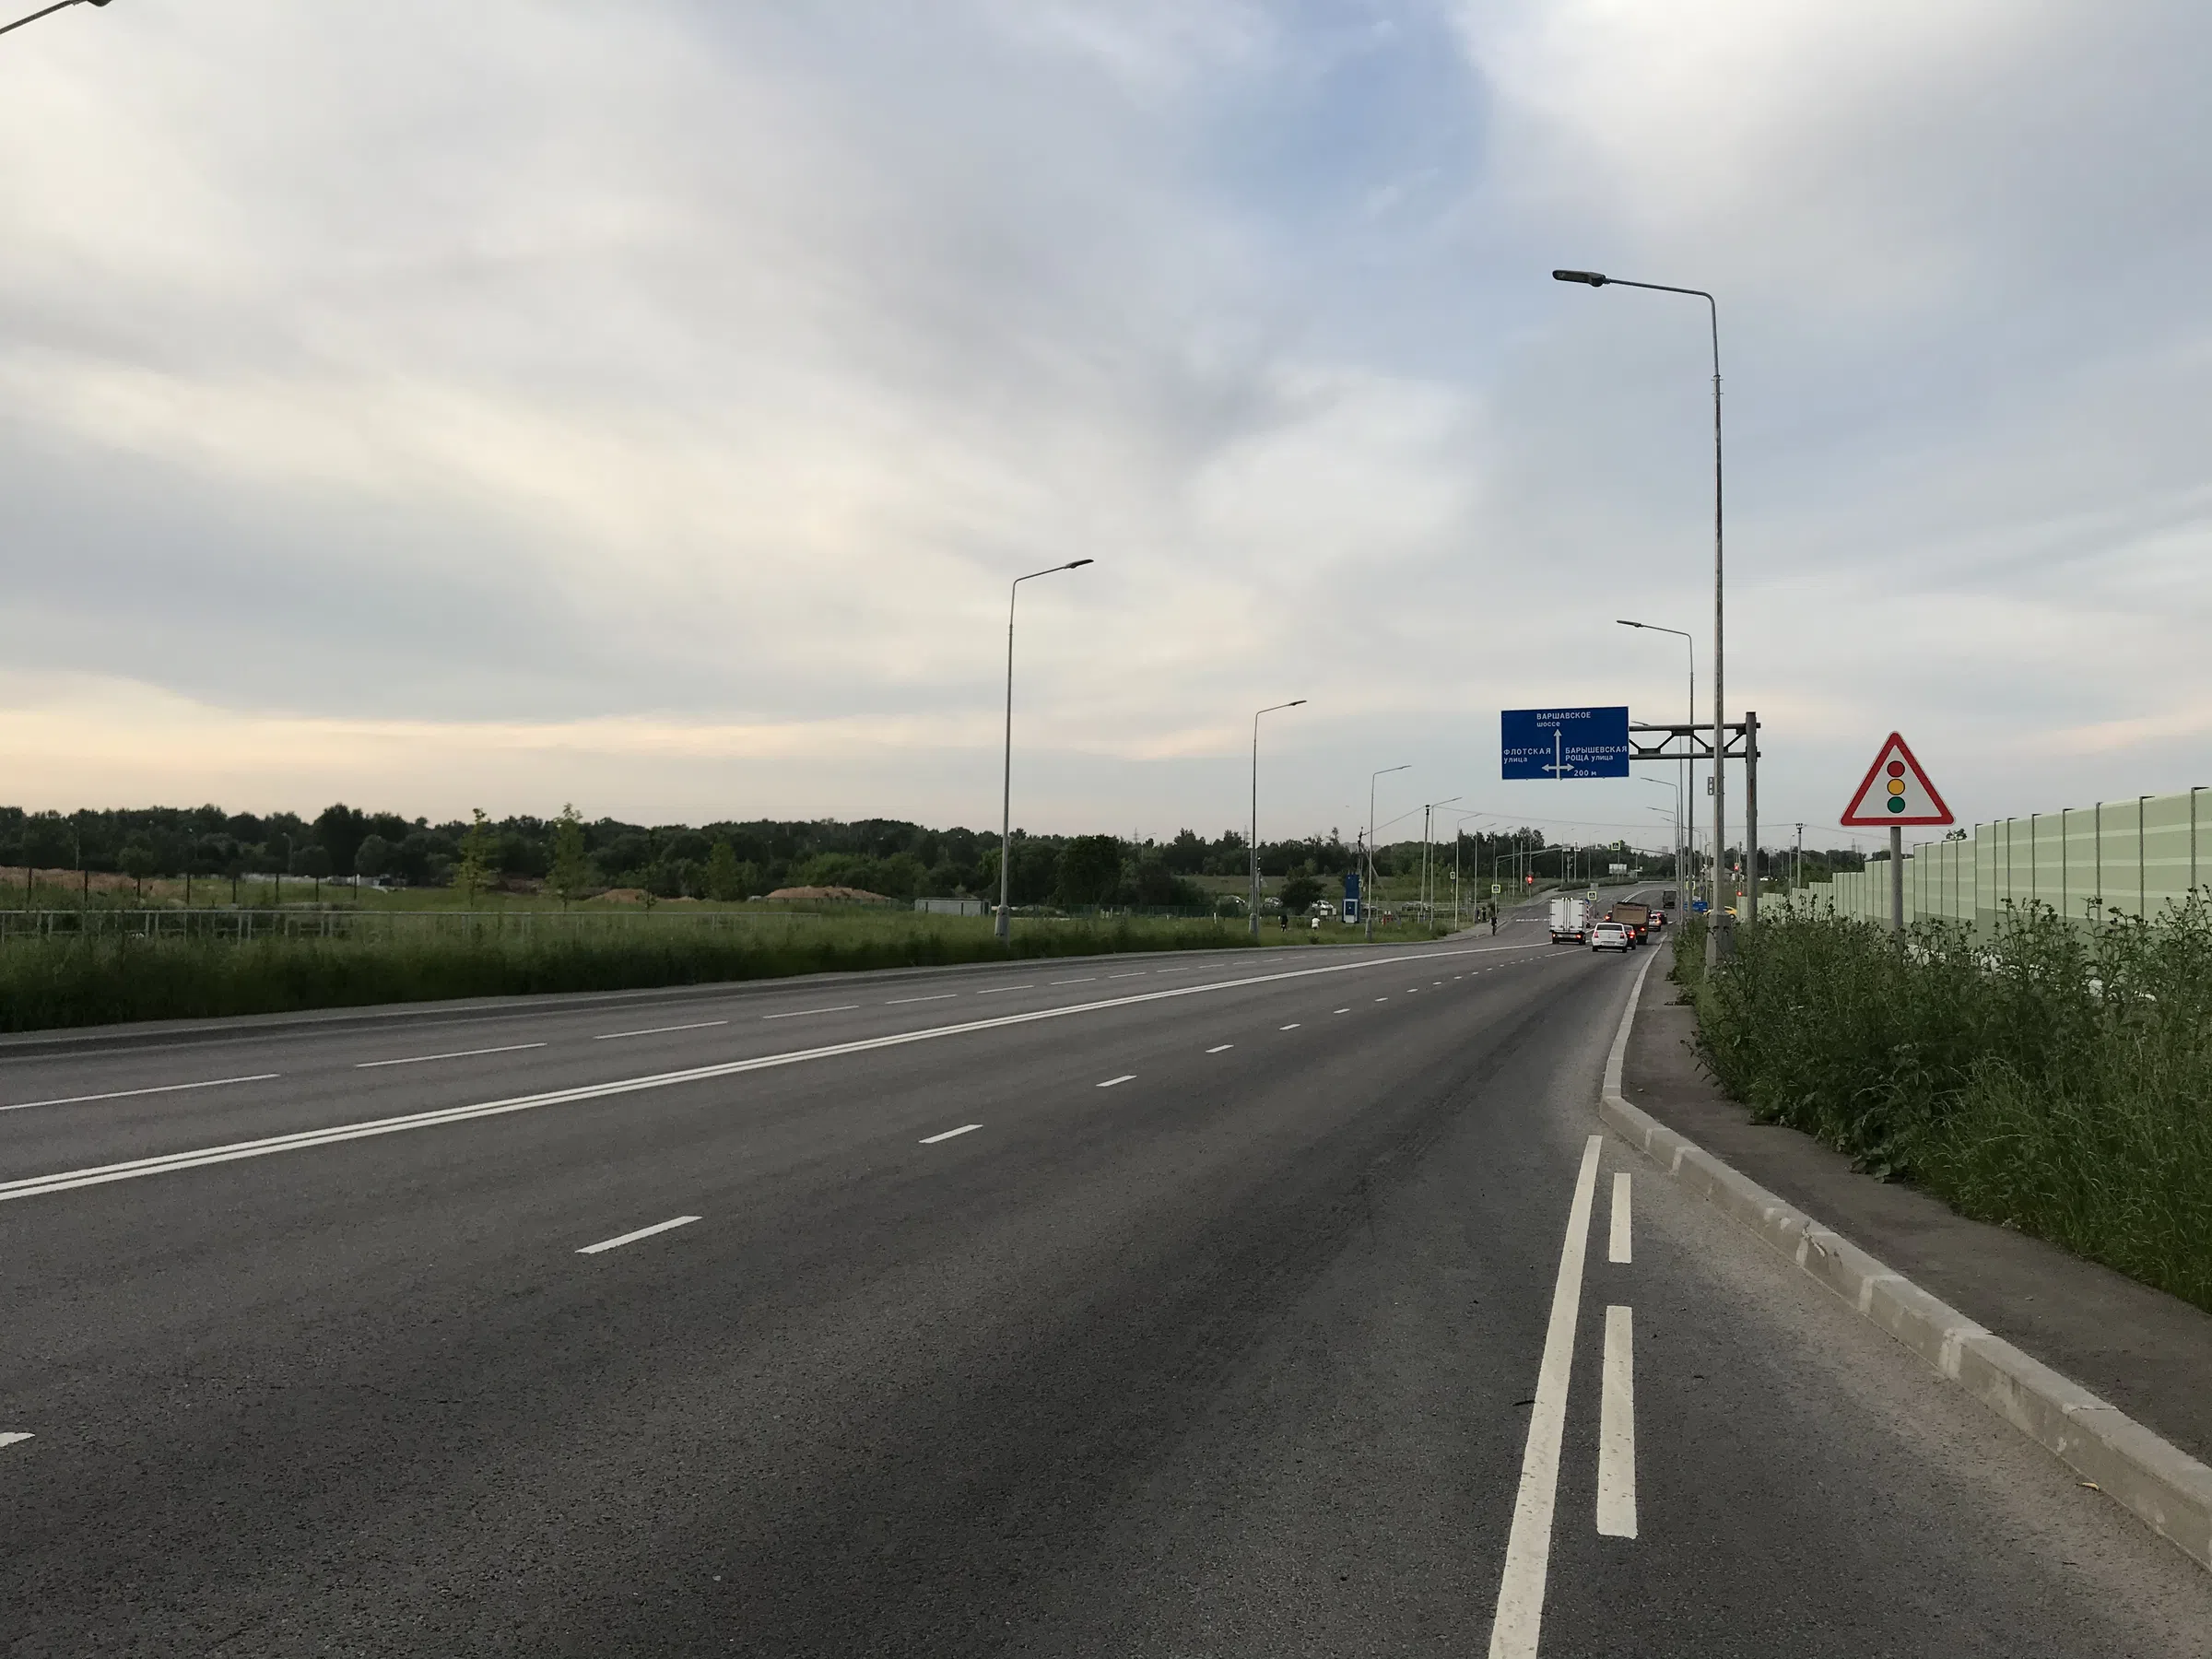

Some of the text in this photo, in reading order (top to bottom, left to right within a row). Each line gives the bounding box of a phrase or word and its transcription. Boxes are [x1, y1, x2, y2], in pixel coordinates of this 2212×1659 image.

[1536, 712, 1592, 720] ВАРШАВСКОЕ
[1503, 747, 1551, 756] ФЛОТСКАЯ
[1565, 746, 1628, 754] БАРЫШЕВСКАЯ
[1503, 756, 1528, 765] улица
[1565, 754, 1614, 763] РОЩА улица
